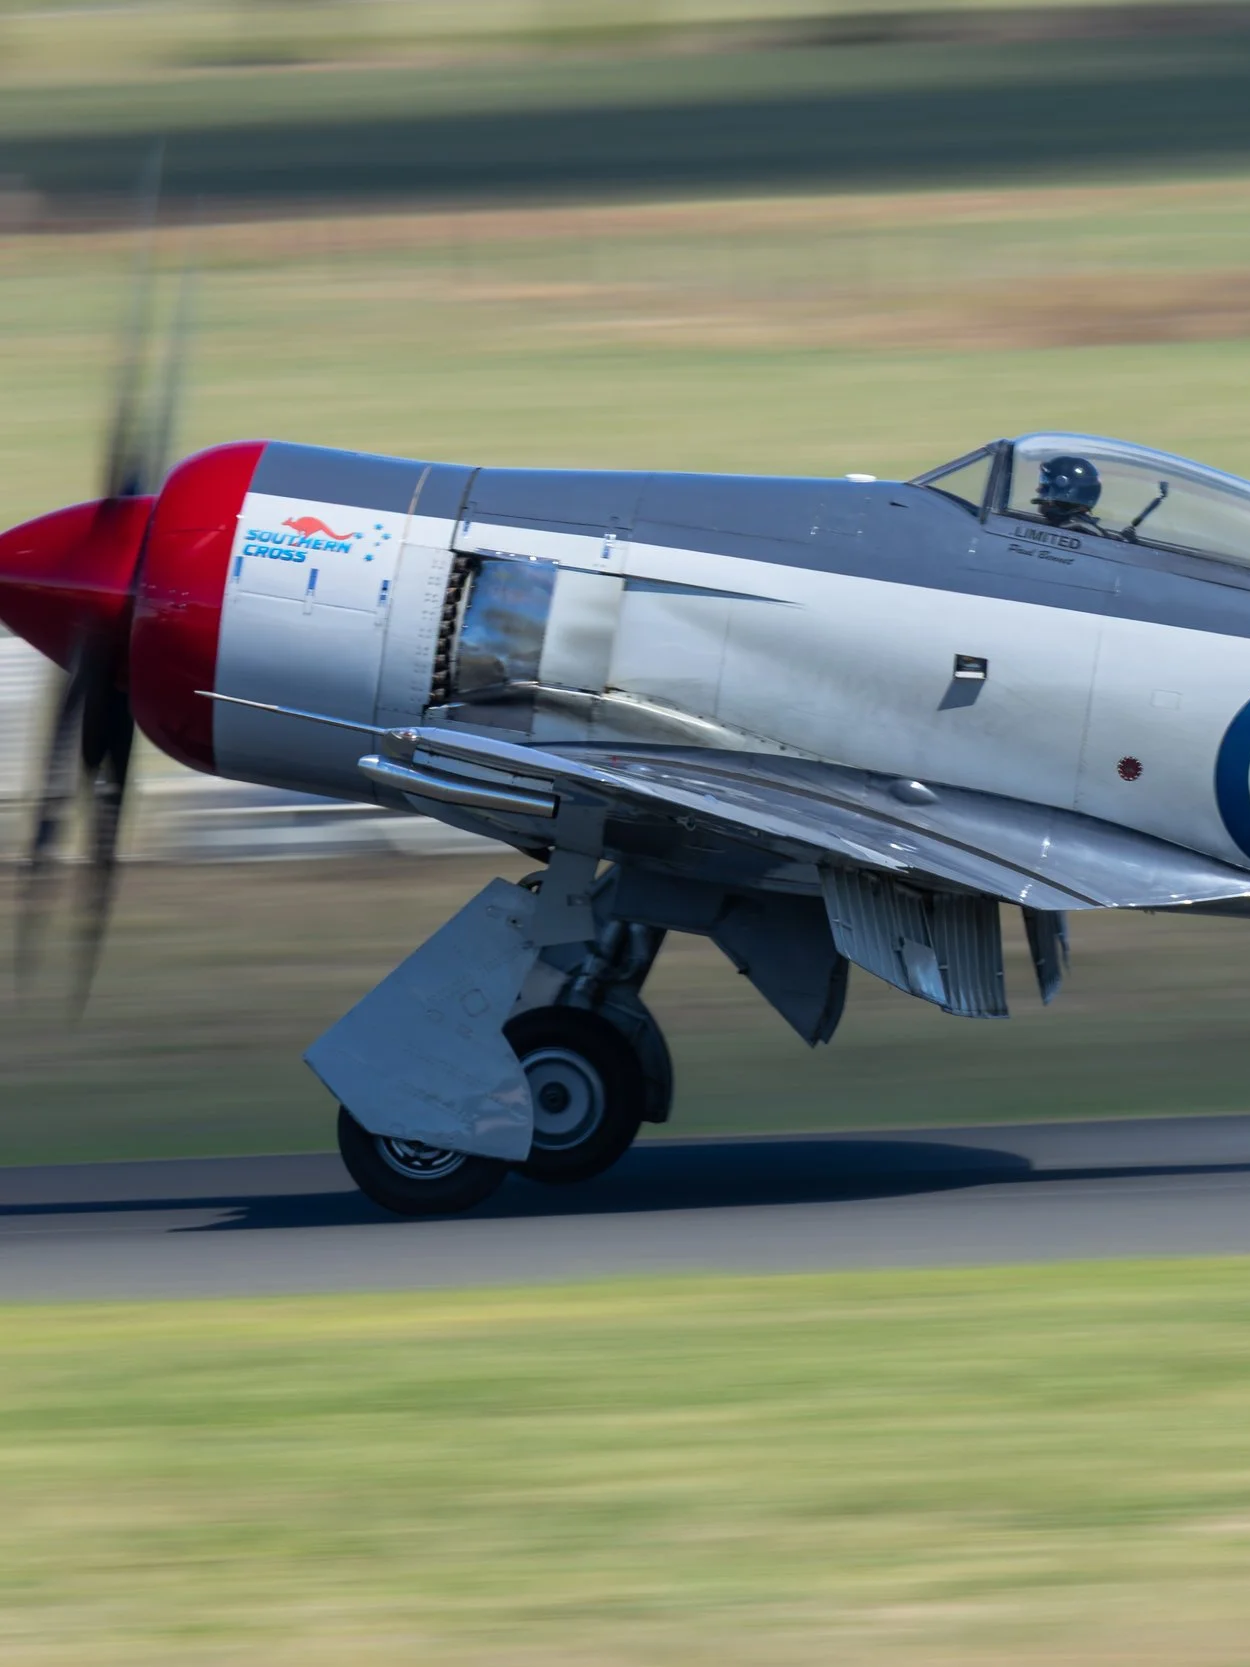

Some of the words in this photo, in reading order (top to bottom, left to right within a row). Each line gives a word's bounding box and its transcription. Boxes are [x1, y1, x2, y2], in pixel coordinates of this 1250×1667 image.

[244, 529, 353, 554] SOUTHERN
[1013, 527, 1082, 549] LIMITED
[243, 543, 308, 563] CROSS
